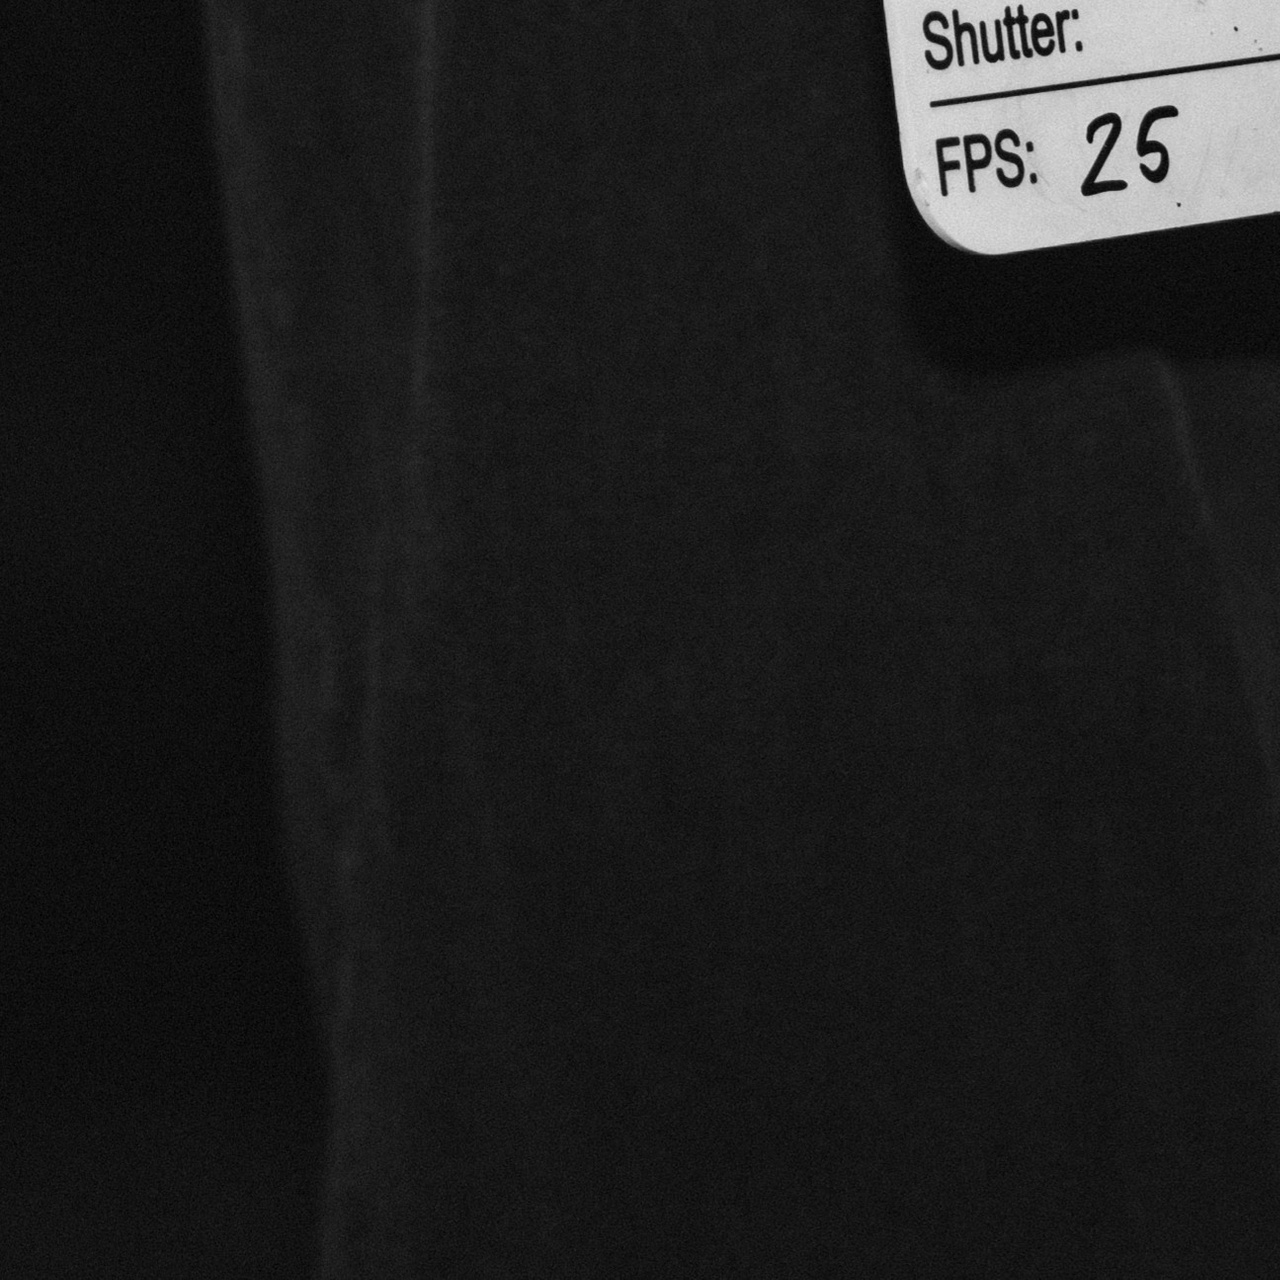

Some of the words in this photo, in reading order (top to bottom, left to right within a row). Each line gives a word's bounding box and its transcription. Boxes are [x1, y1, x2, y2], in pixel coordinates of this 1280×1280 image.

[922, 5, 1084, 71] Shutter:
[935, 128, 1039, 197] FPS:
[1080, 104, 1180, 197] 25
